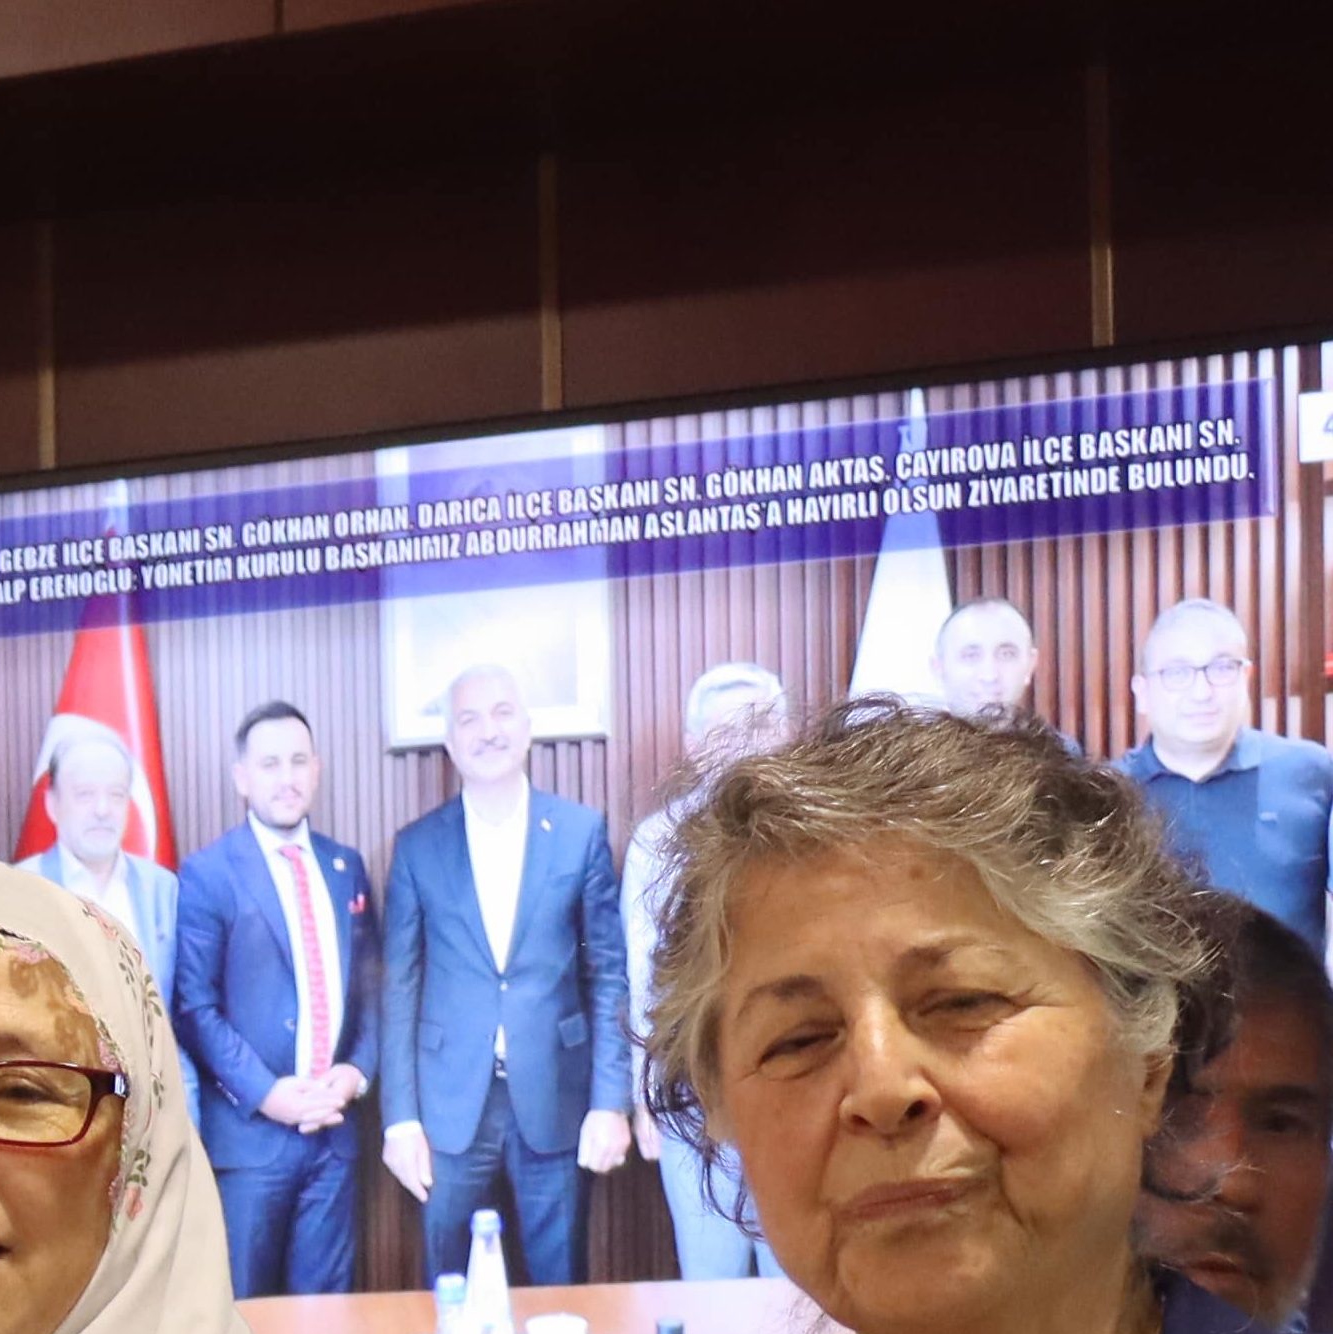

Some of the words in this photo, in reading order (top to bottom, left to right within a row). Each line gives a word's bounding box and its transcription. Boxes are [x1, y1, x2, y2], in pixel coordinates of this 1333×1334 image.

[204, 524, 237, 552] SN.
[417, 496, 502, 529] DARICA
[664, 475, 702, 503] SN.
[706, 465, 803, 500] GÖKHAN
[1199, 418, 1241, 448] SN.
[236, 547, 321, 580] KURULU
[465, 516, 639, 557] ABDURRAHMAN
[786, 490, 878, 525] HAYIRLI
[882, 482, 962, 516] OLSUN
[968, 465, 1121, 507] ZİYARETİNDE
[1128, 453, 1255, 490] BULUNDU.
